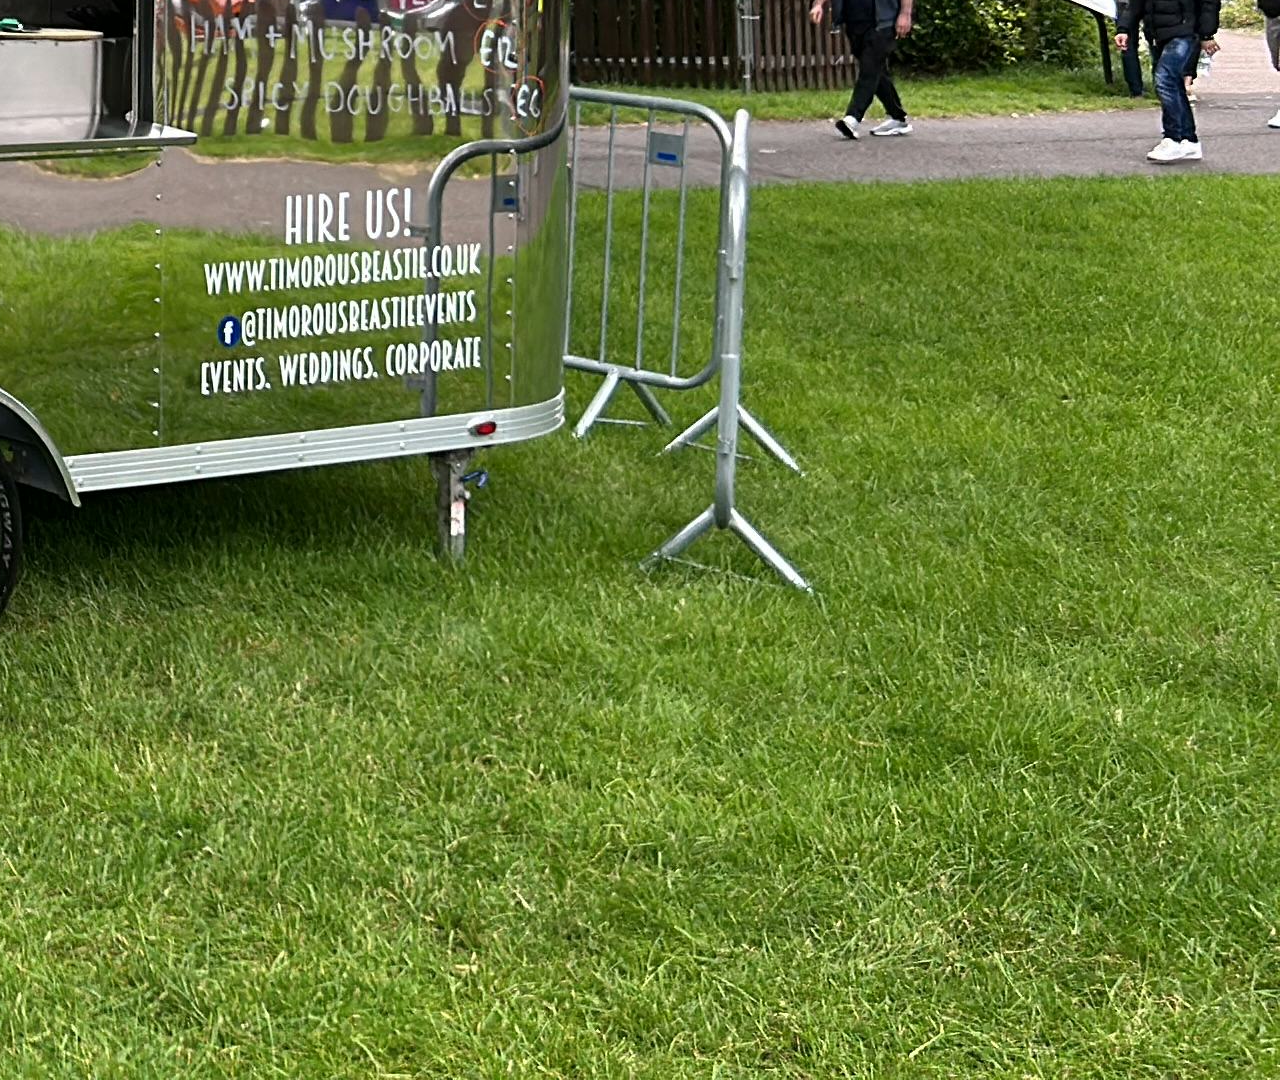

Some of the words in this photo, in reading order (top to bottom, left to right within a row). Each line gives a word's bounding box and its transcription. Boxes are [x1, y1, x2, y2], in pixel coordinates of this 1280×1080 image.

[290, 20, 457, 64] MUSHROOM
[285, 191, 350, 245] HIRE
[366, 187, 412, 240] US!
[203, 243, 481, 296] WWW.TIMOROUSBEASTIE.CO.UK
[241, 290, 477, 347] @TIMOROUSBEASTIEEVENTS
[201, 356, 271, 396] EVENTS.
[279, 347, 379, 387] WEDDINGS.
[385, 336, 481, 377] CORPORATE
